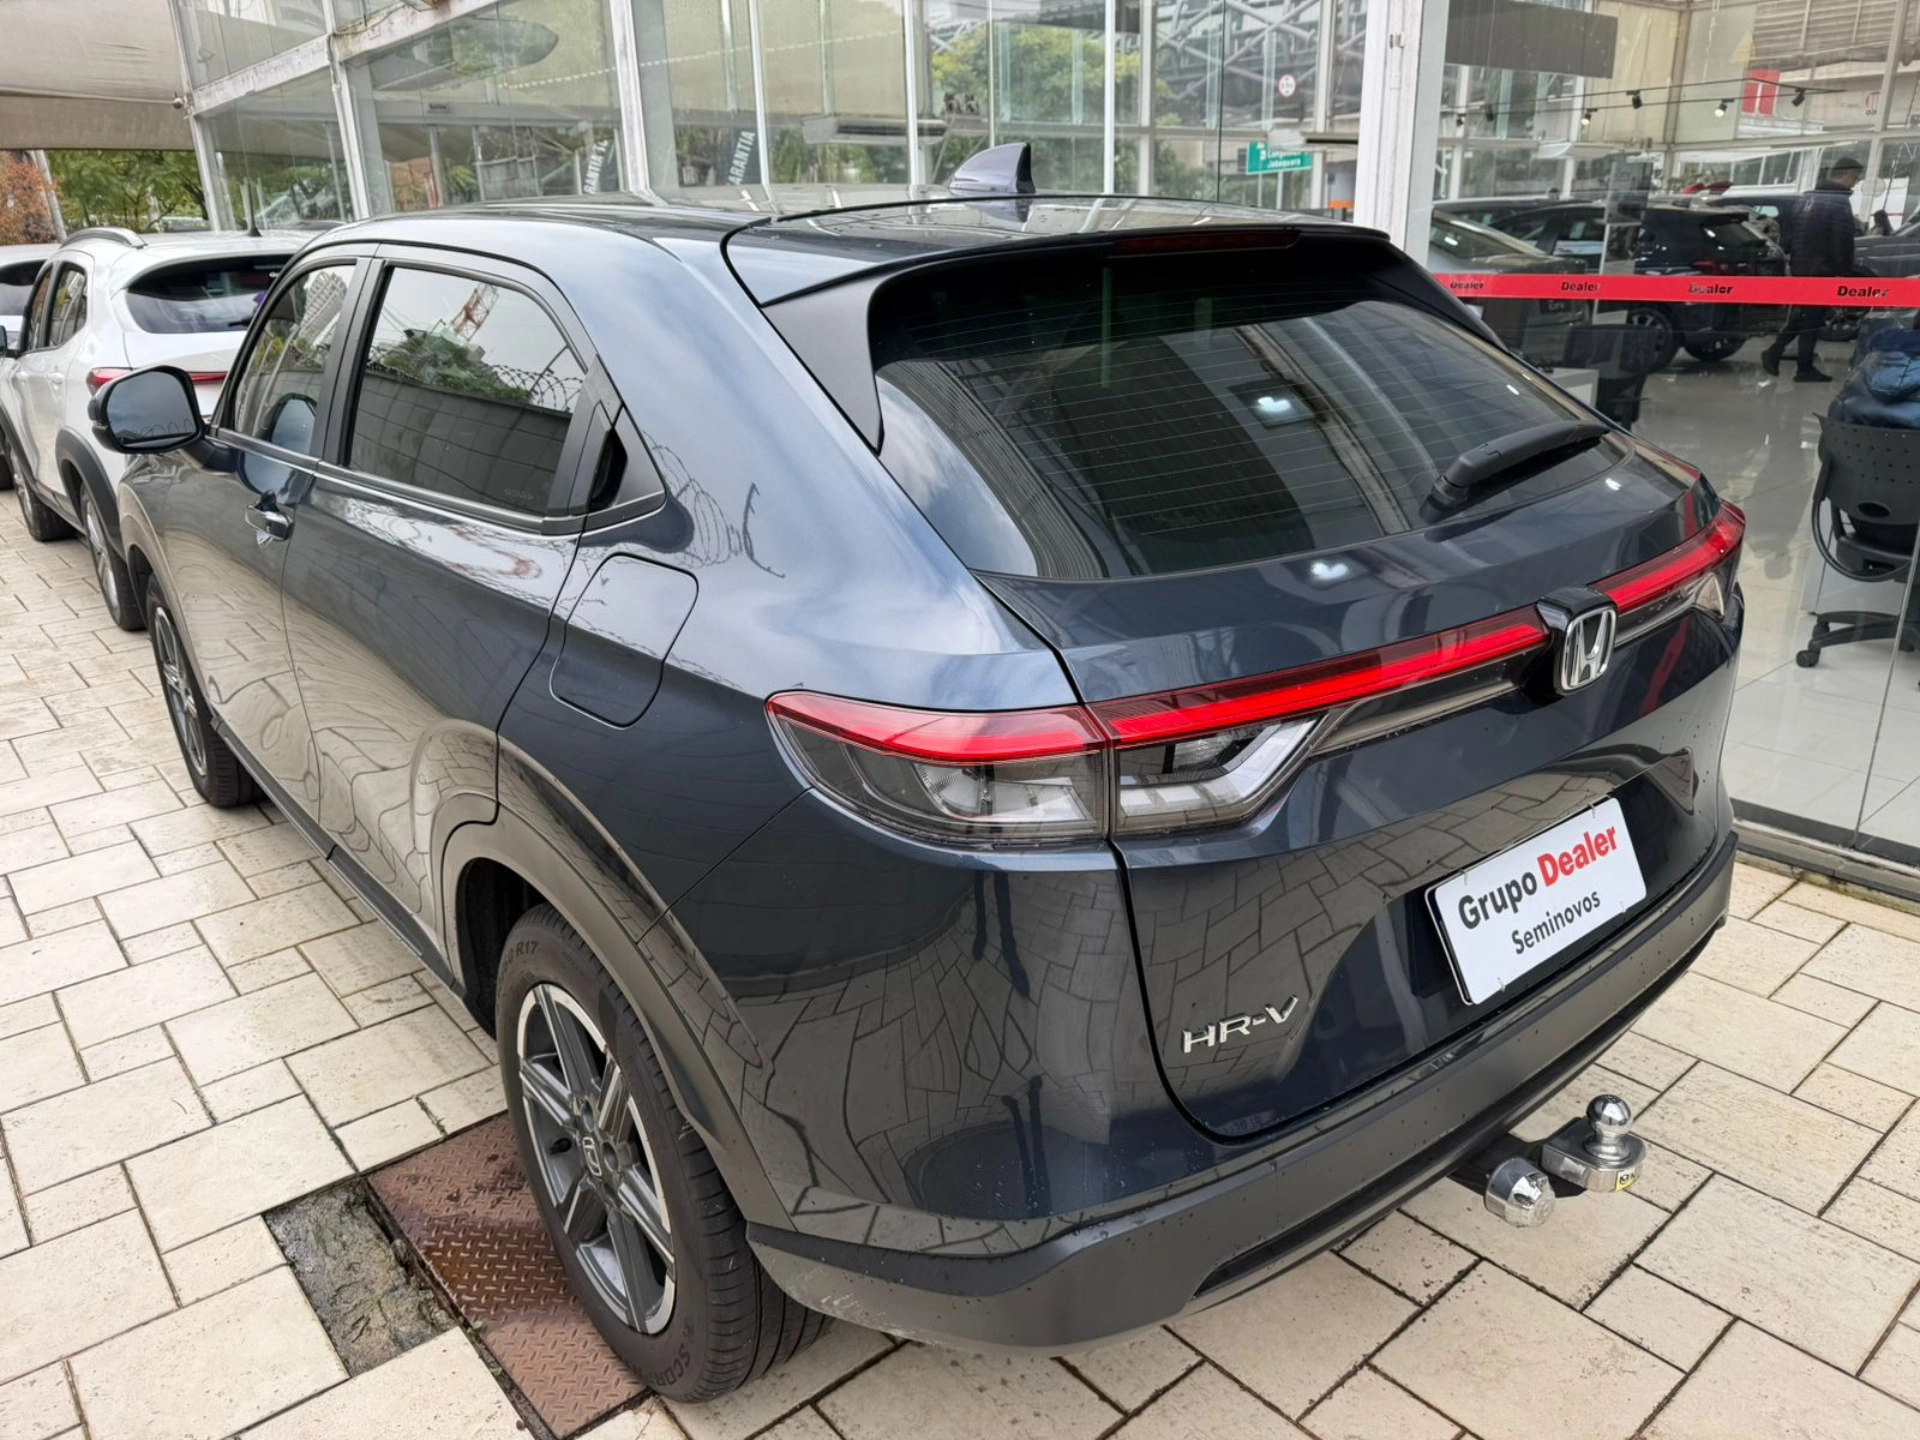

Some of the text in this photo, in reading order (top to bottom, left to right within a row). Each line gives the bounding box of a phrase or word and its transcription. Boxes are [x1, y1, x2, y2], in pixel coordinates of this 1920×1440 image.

[727, 131, 756, 186] ARANTIA
[1561, 281, 1599, 292] Dealer
[1688, 283, 1733, 295] Dealer
[1837, 285, 1890, 298] Dealer
[1458, 825, 1619, 930] Grupo Dealer
[1511, 890, 1601, 955] Seminovos
[1181, 994, 1299, 1054] HR-V
